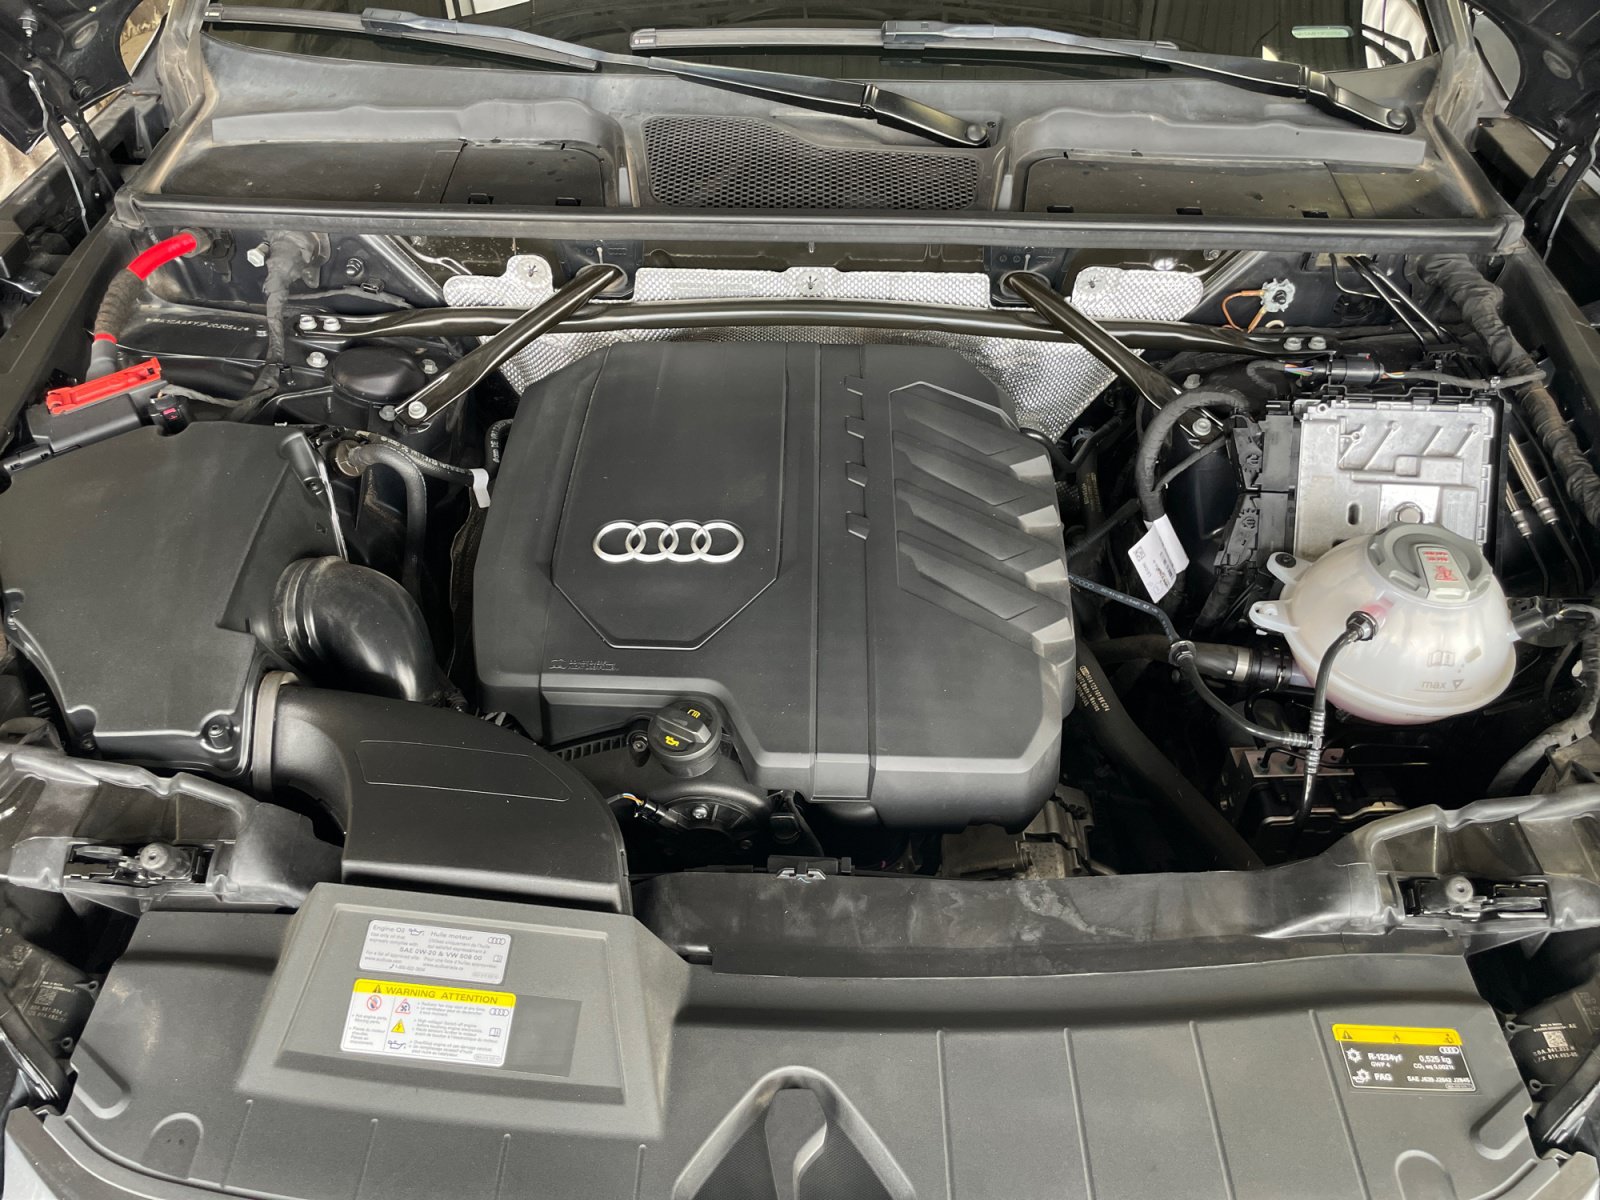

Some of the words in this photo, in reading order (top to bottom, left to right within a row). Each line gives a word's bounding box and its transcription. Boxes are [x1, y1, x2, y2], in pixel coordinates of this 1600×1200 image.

[1422, 679, 1447, 689] max
[372, 924, 395, 933] Engine
[414, 948, 436, 956] 0W-20
[386, 986, 436, 999] WARNING
[440, 992, 498, 1005] ATTENTION
[1367, 1052, 1403, 1063] R-1234yf
[1440, 1056, 1452, 1065] kg
[1374, 1073, 1392, 1081] PAG
